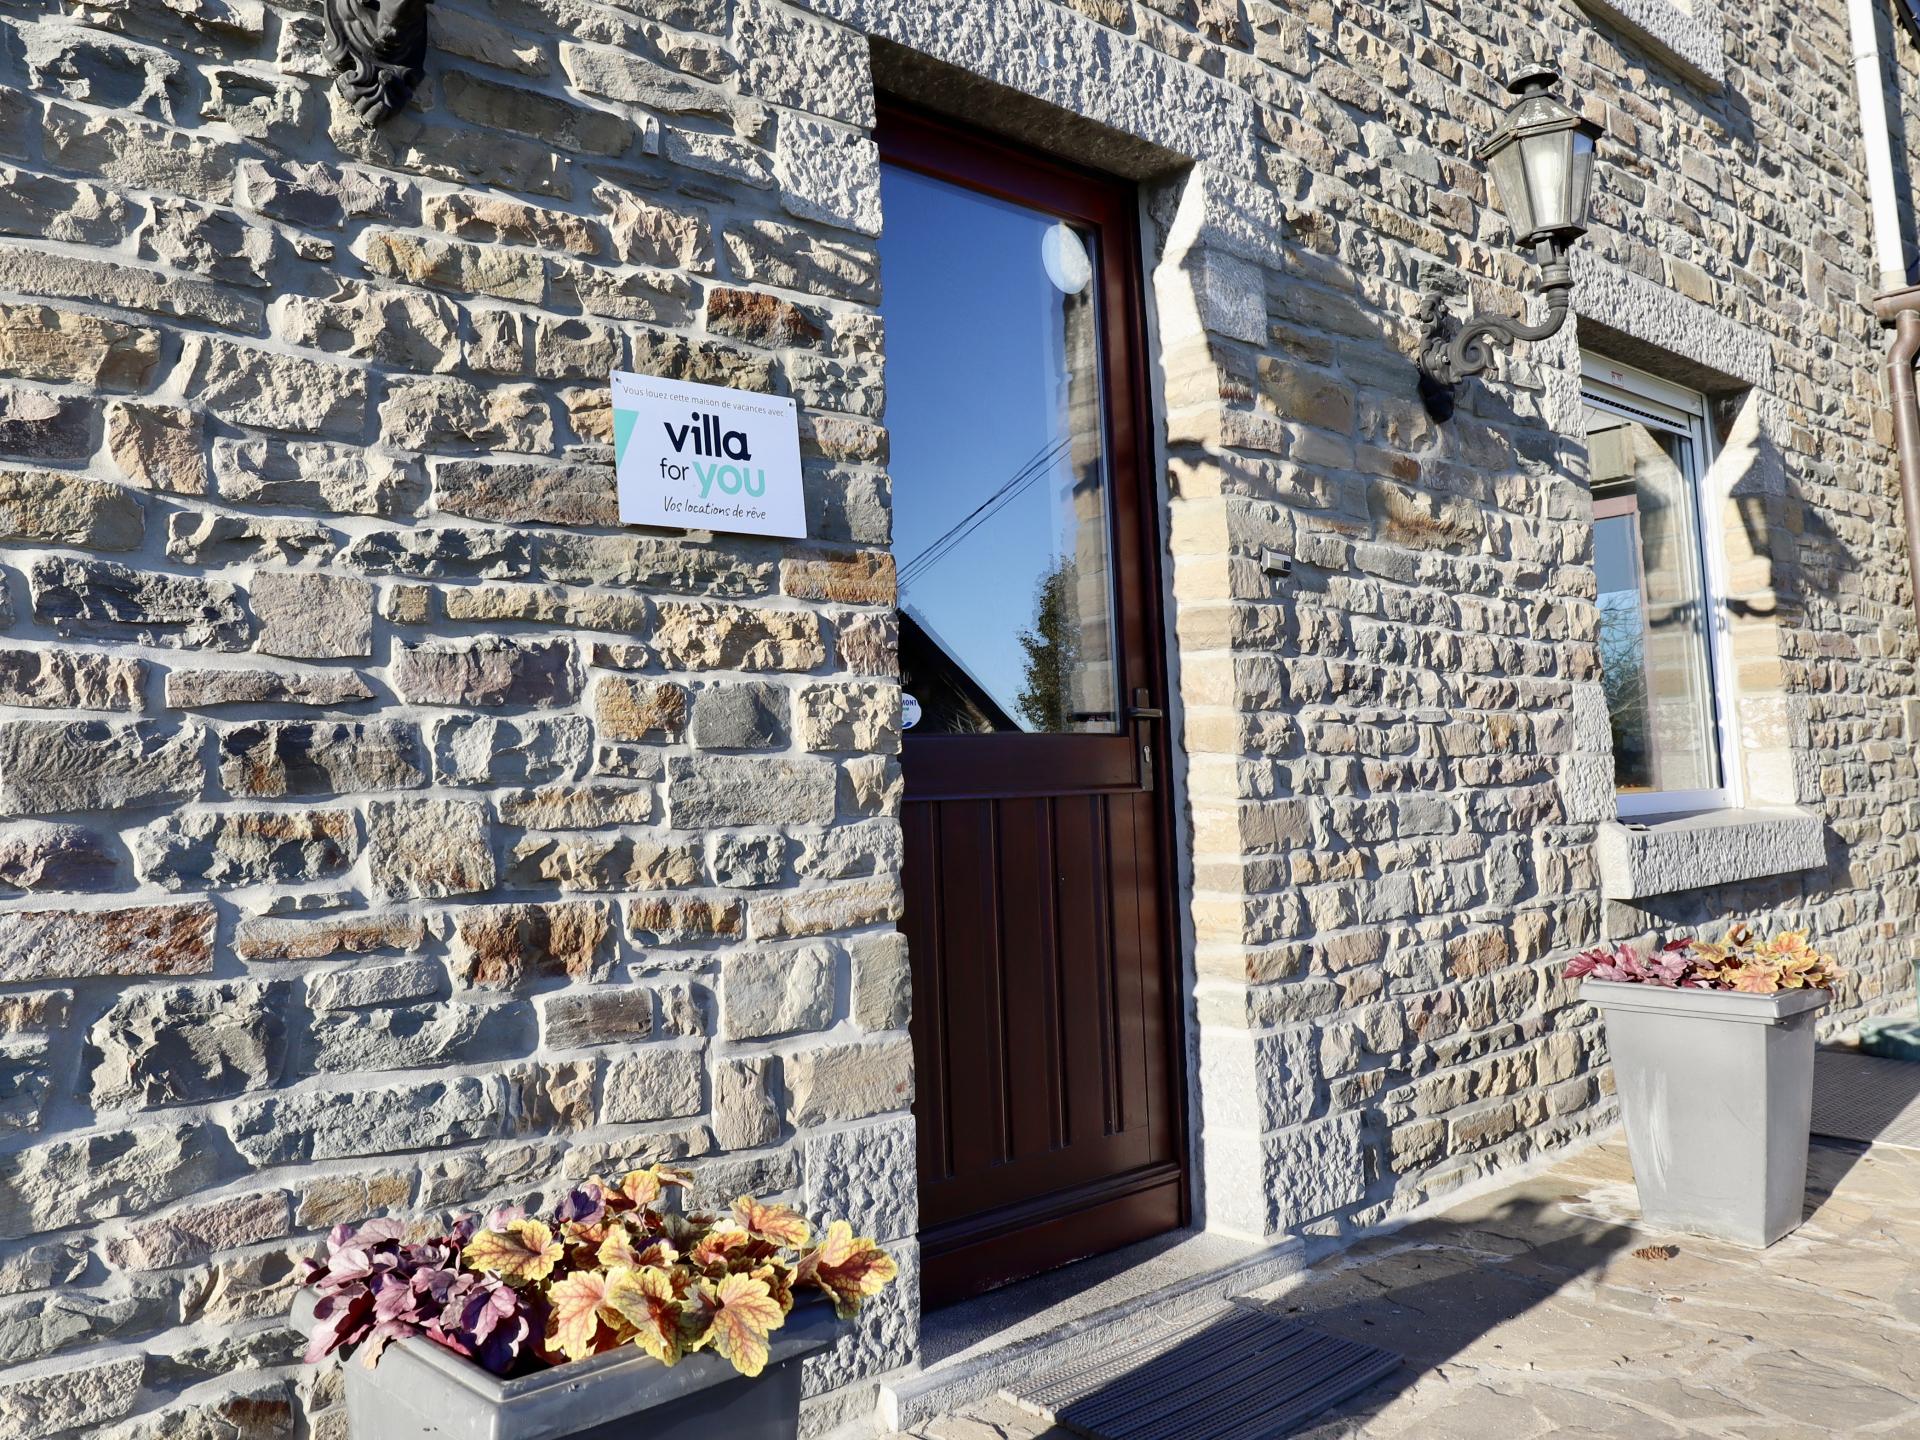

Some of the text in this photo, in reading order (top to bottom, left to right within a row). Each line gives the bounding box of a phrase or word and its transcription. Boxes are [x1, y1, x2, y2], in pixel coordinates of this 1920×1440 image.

[623, 385, 784, 416] Vous louez cette maison de vacances avec
[663, 411, 752, 461] villa
[660, 457, 766, 499] for you
[664, 495, 767, 520] Vos locations de rêve
